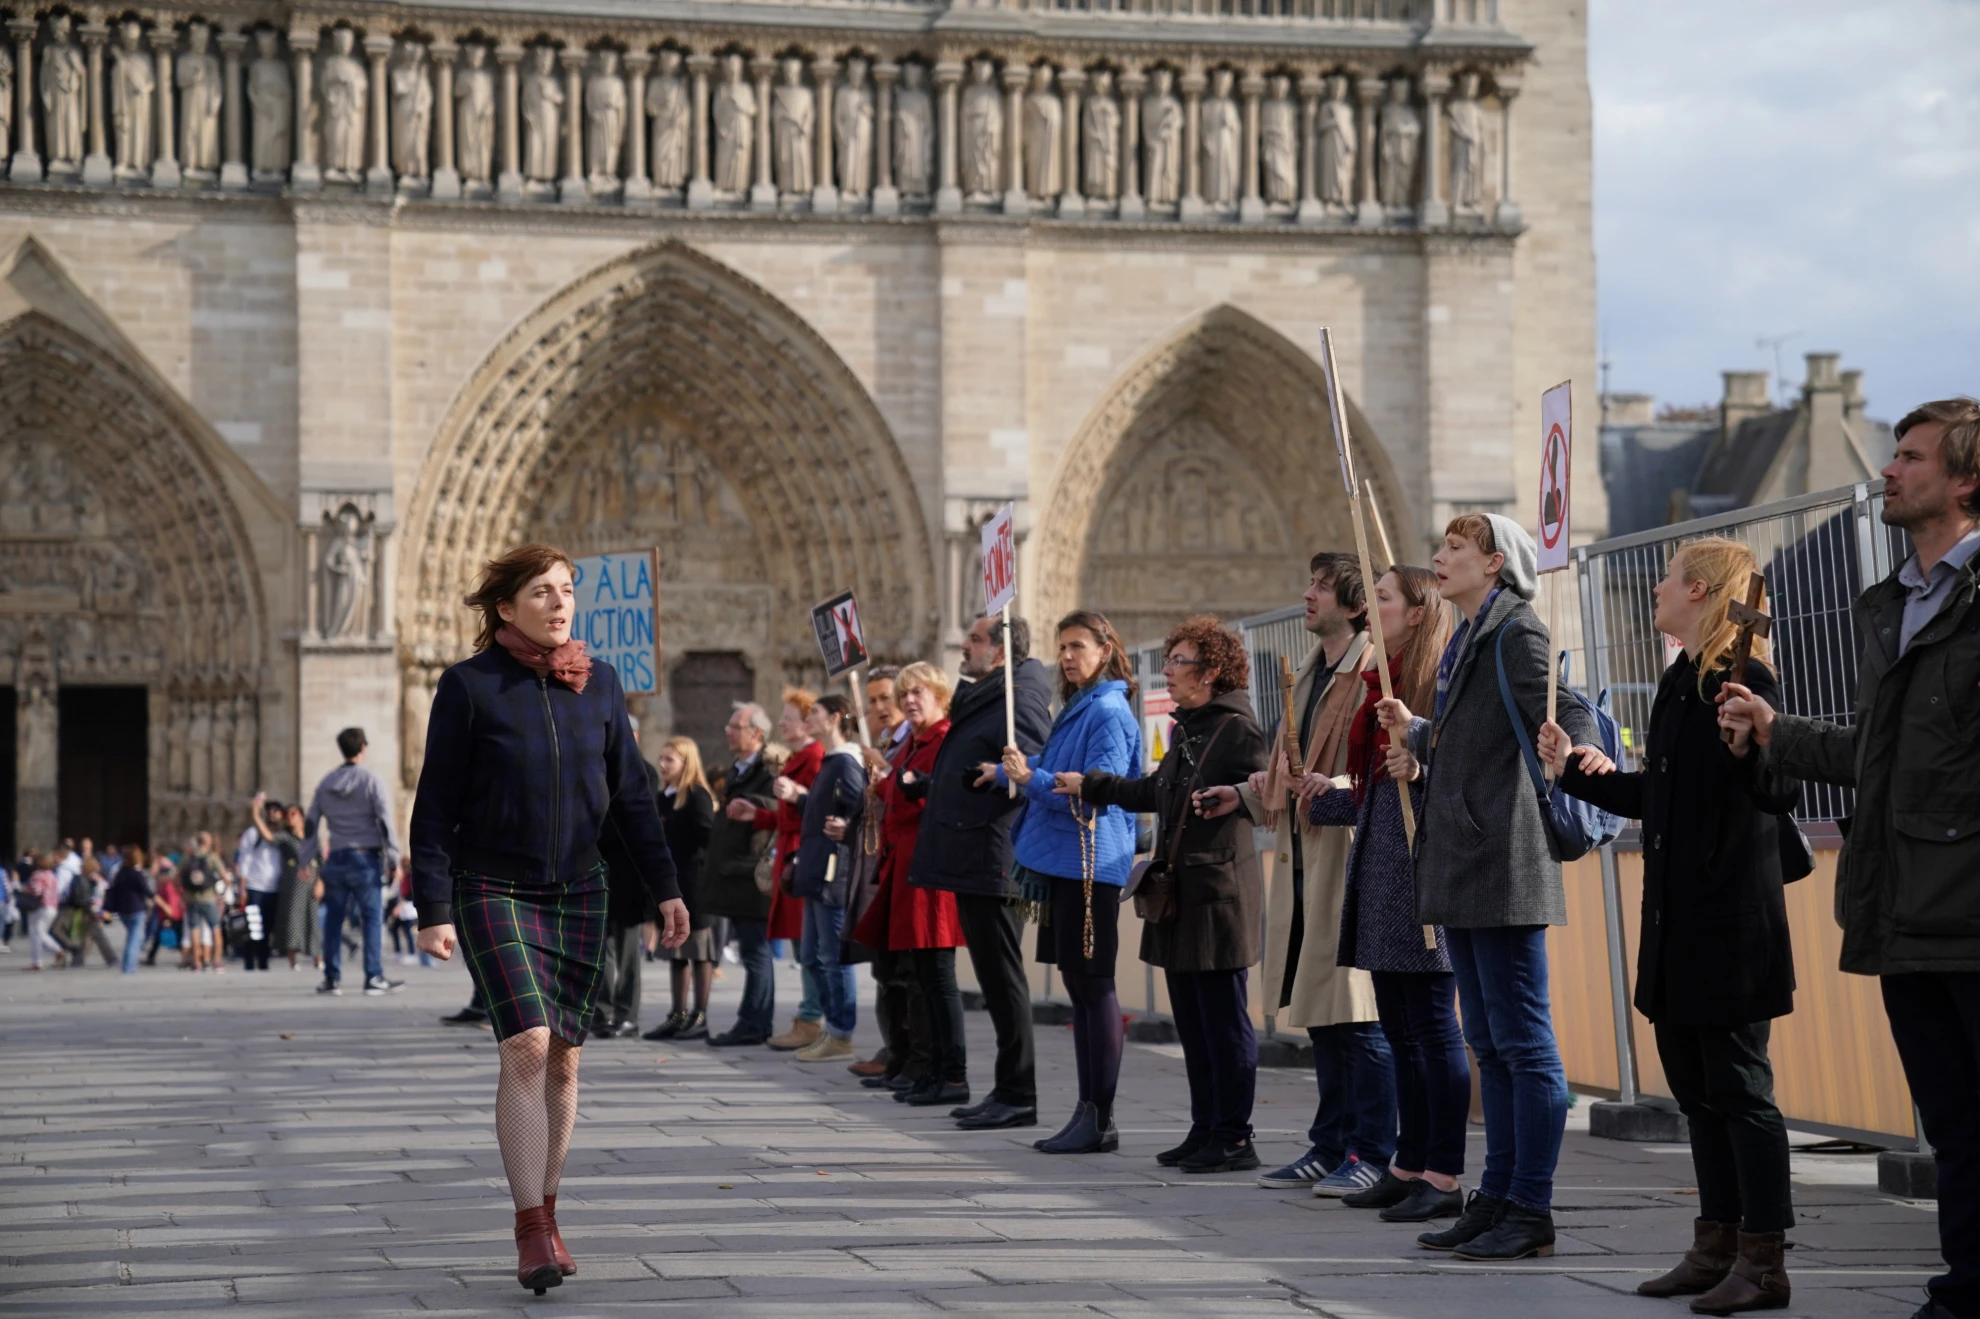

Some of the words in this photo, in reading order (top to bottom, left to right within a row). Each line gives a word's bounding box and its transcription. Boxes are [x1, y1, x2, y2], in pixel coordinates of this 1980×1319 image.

[594, 556, 617, 602] À
[621, 559, 653, 599] LA
[570, 607, 653, 649] UCTION
